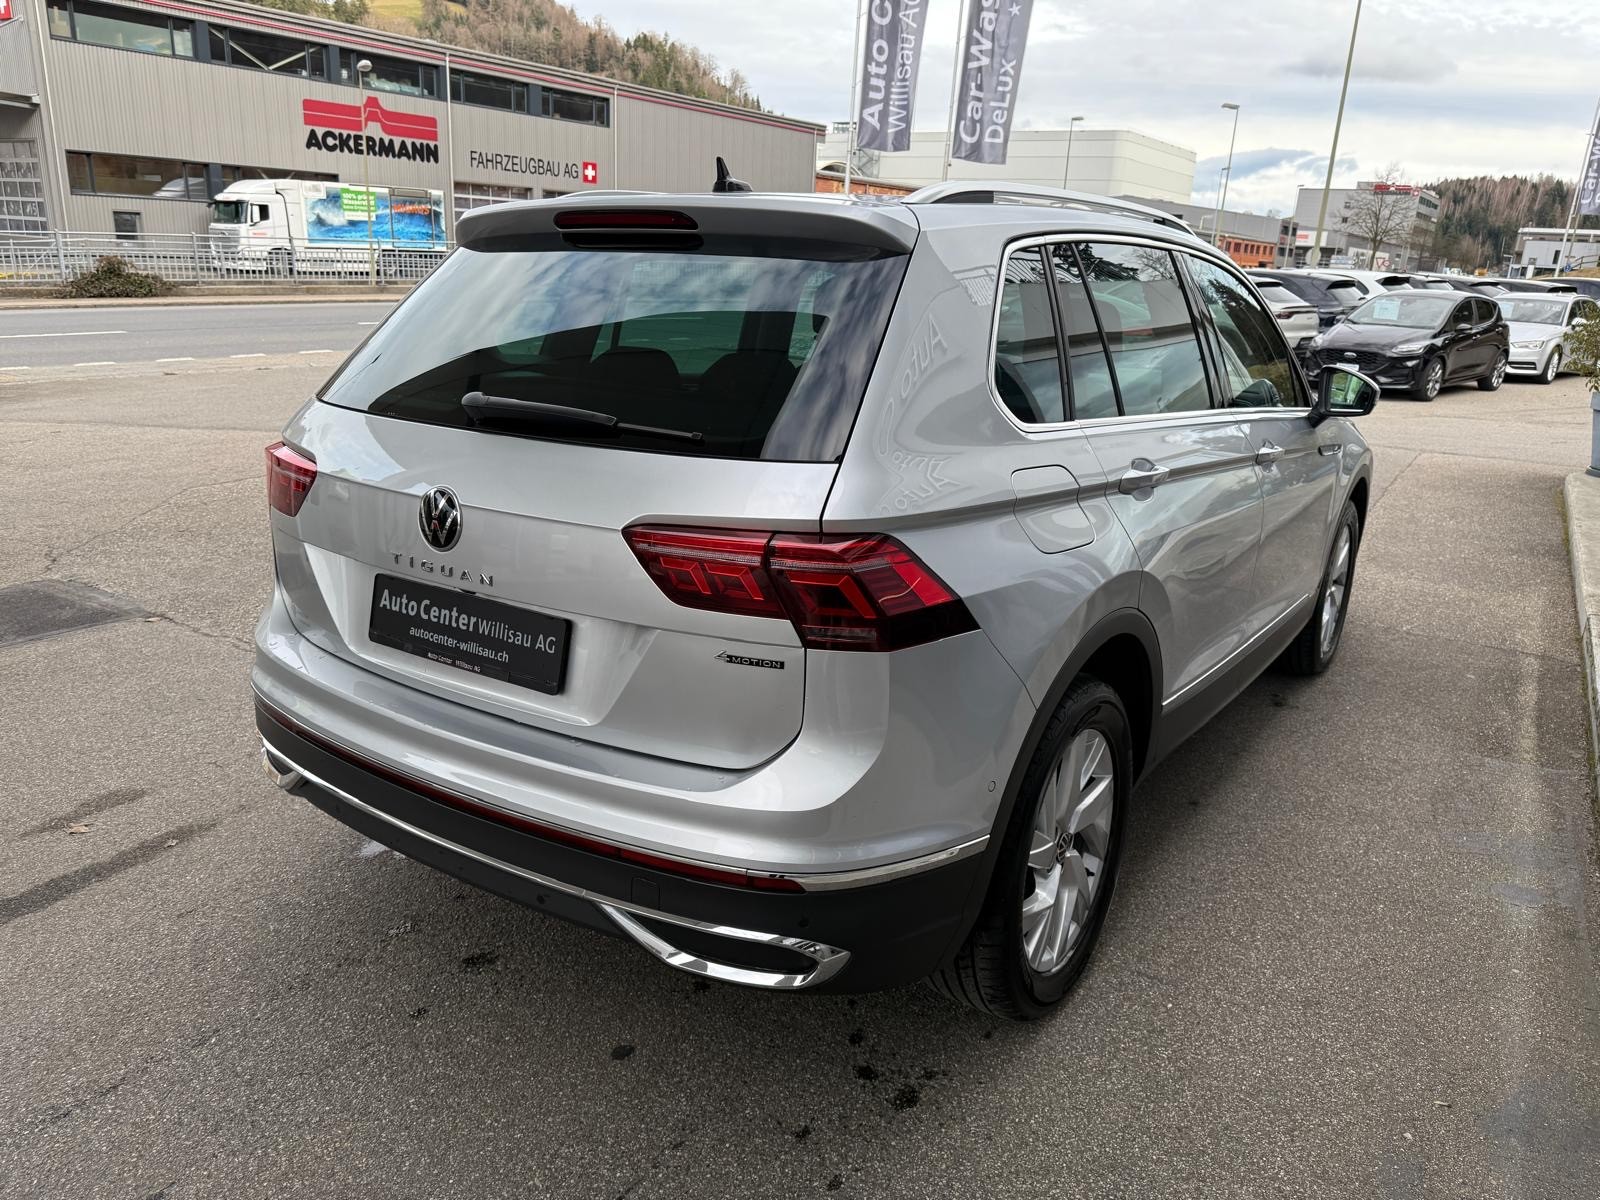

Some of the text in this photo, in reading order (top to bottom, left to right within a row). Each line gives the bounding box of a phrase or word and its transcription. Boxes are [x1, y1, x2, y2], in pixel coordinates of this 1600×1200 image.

[862, 38, 889, 129] Auto
[888, 33, 916, 133] Willisau
[984, 59, 1016, 143] DeLux
[305, 128, 439, 164] ACKERMANN
[470, 150, 579, 179] FAHRZEUGBAU AG
[392, 552, 493, 587] TIGUAN
[409, 626, 509, 663] autocenter-willisau.ch
[478, 617, 532, 648] Willisau
[535, 633, 556, 654] AG
